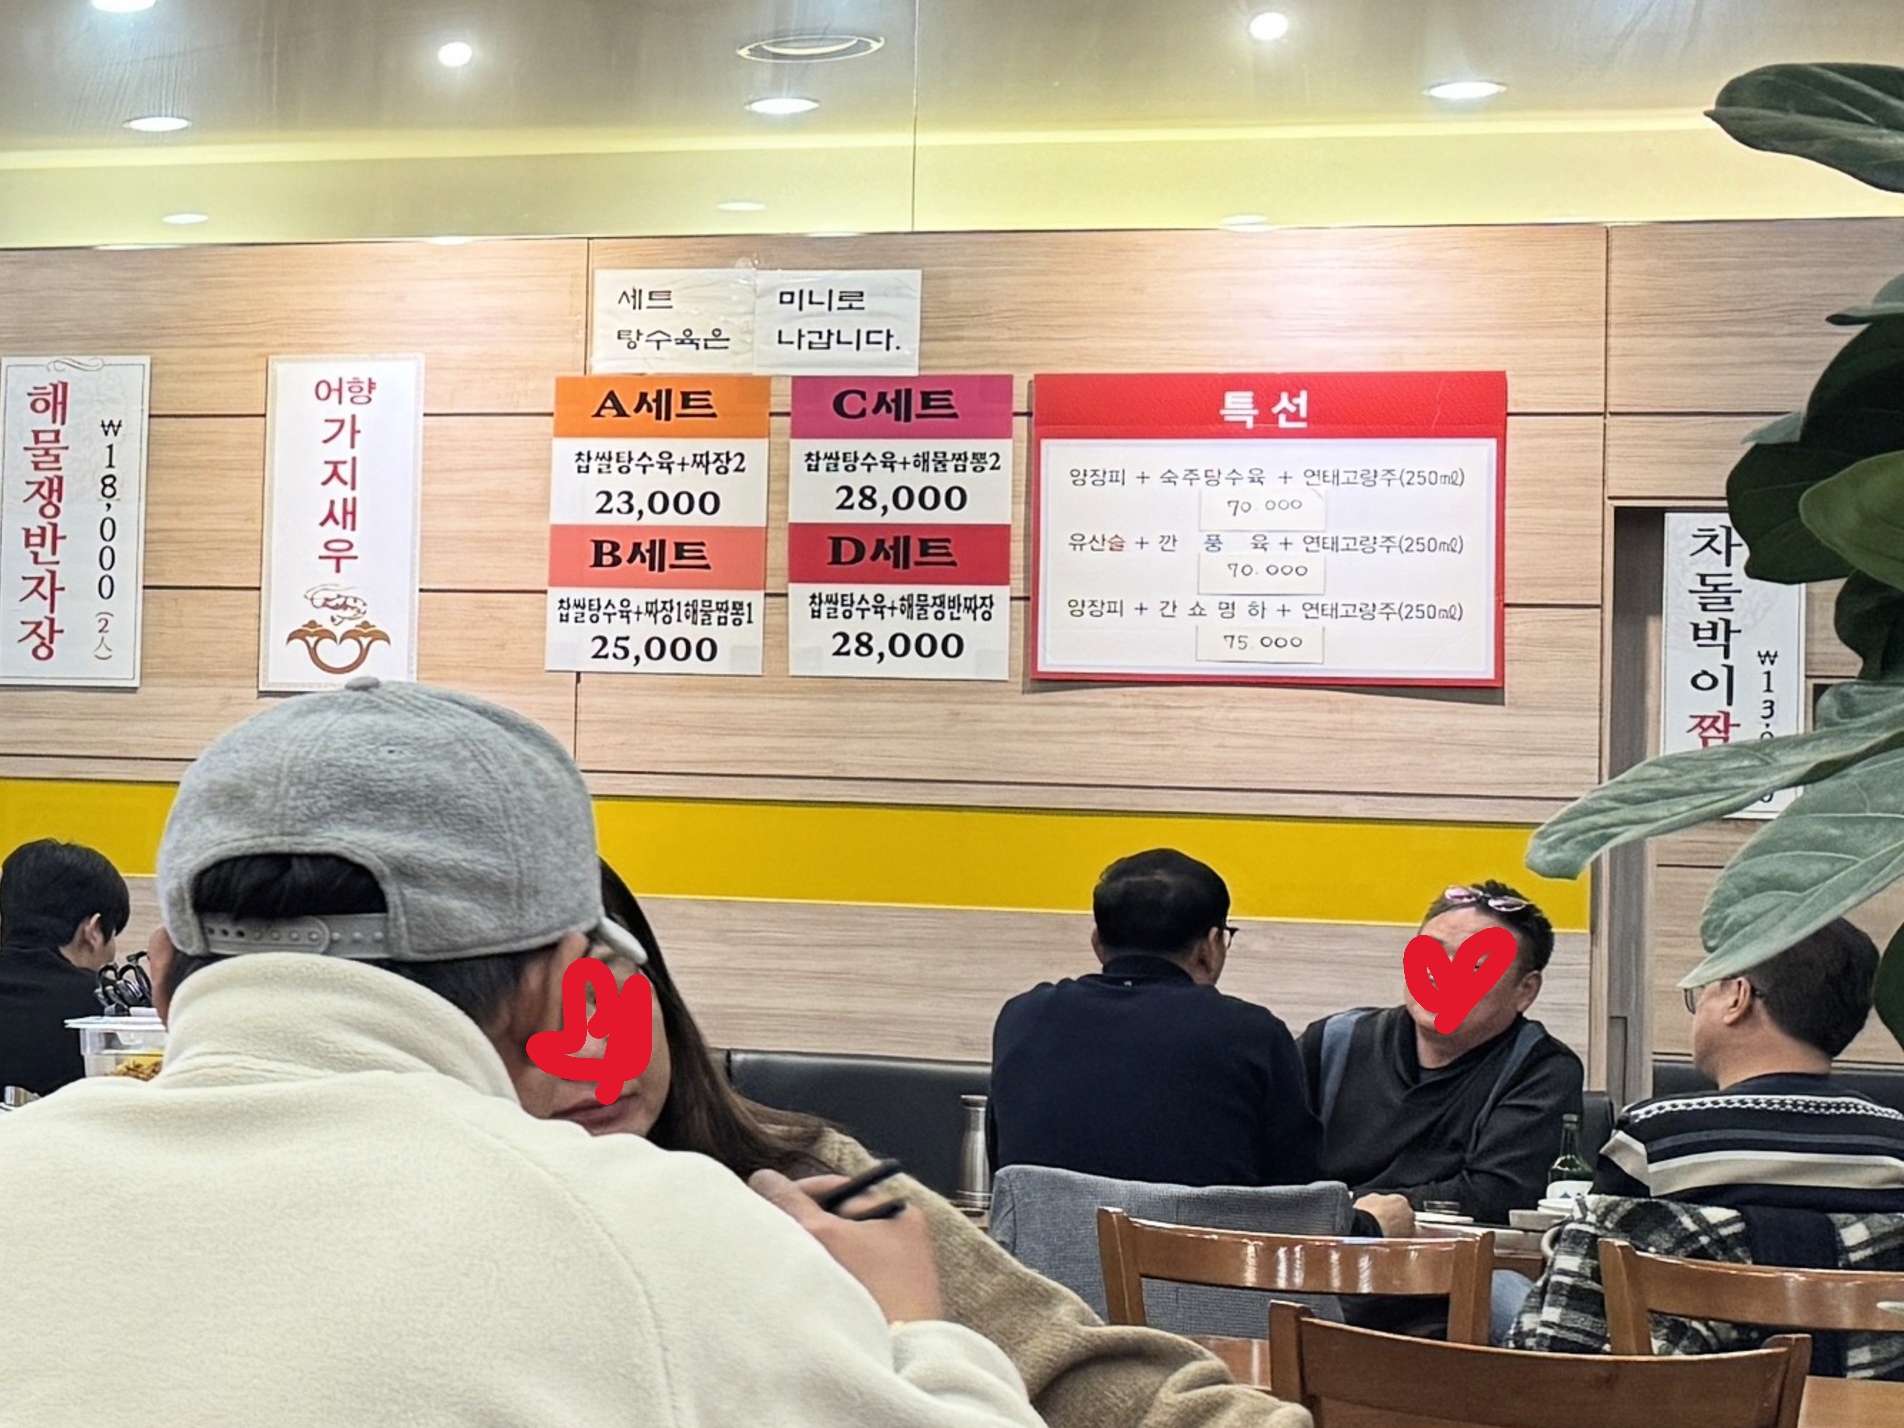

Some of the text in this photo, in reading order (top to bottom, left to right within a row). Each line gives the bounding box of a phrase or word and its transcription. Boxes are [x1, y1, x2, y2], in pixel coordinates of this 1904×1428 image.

[617, 287, 673, 311] 세트
[778, 288, 866, 312] 미니로
[616, 327, 731, 351] 탕수육은
[776, 328, 901, 352] 나갑니다.
[314, 376, 378, 407] 어향
[590, 387, 719, 422] A세트
[832, 387, 960, 423] C세트
[317, 412, 362, 575] 가지새우
[594, 489, 721, 521] 23,000
[834, 484, 968, 518] 28,000
[17, 379, 71, 662] 해물쟁반자장
[588, 538, 712, 573] B세트
[826, 534, 959, 570] D세트
[1068, 532, 1126, 552] 유산슬
[590, 634, 719, 668] 25,000
[830, 631, 966, 665] 28,000
[1686, 524, 1743, 749] 차돌박이짬
